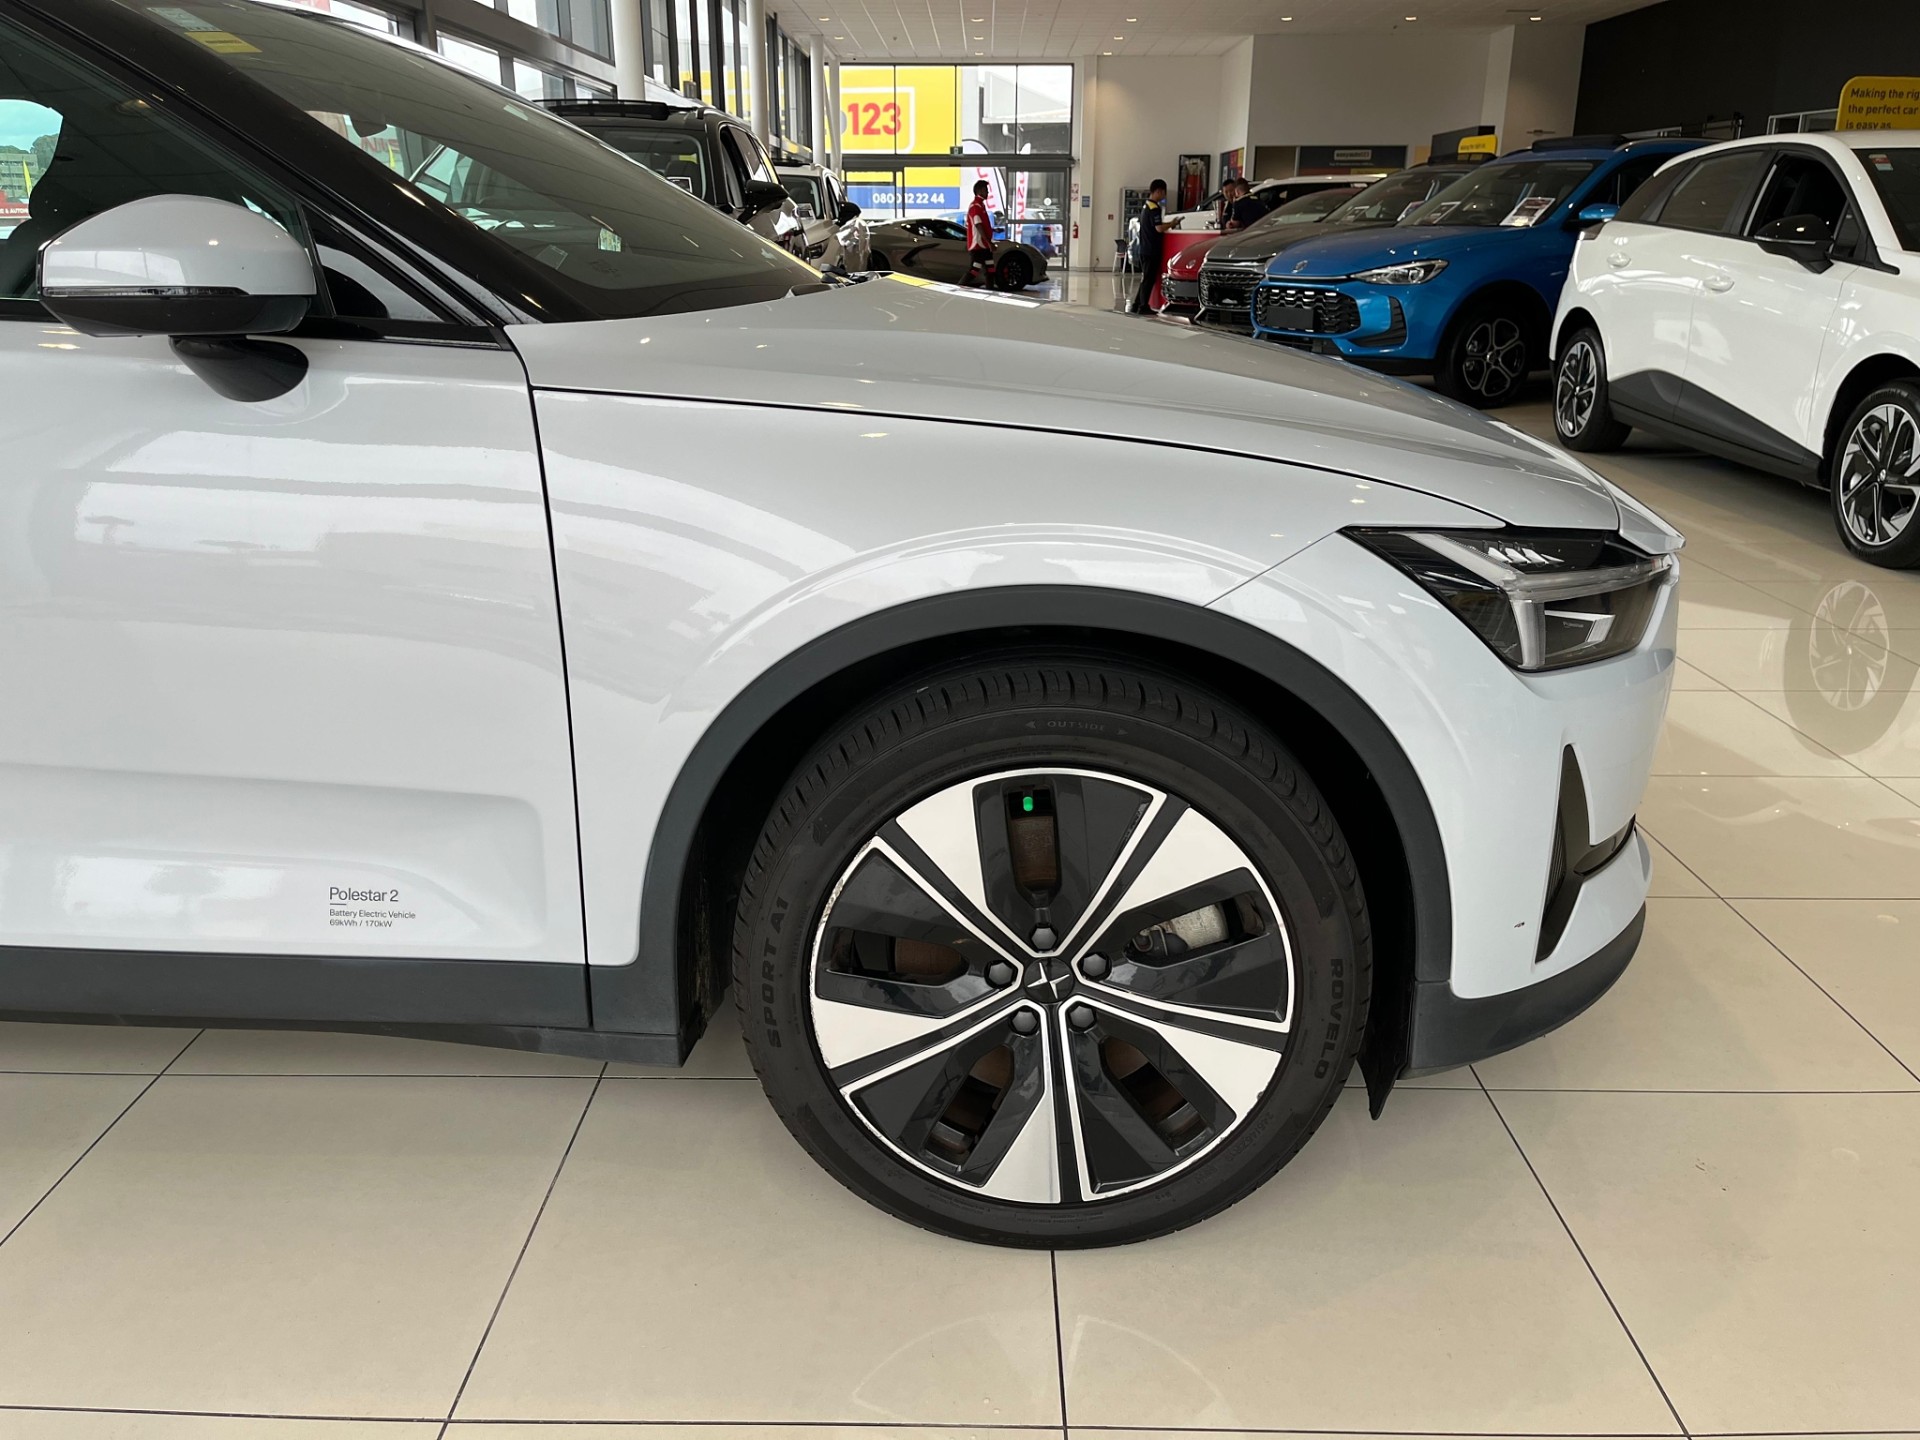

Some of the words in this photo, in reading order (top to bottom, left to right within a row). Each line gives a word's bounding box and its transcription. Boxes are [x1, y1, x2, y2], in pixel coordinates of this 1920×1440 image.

[1851, 88, 1886, 100] Making
[1888, 89, 1904, 99] the
[1848, 104, 1864, 114] the
[1866, 105, 1900, 116] perfect
[1903, 107, 1918, 115] car
[1846, 119, 1854, 129] is
[1856, 121, 1879, 129] easy
[1880, 121, 1892, 129] as
[873, 193, 902, 204] 0800
[916, 193, 929, 204] 22
[930, 193, 945, 204] 44
[1047, 720, 1105, 731] OUTSIDE
[329, 887, 387, 901] Polestar
[390, 889, 398, 902] 2
[329, 908, 358, 918] Battery
[359, 910, 387, 918] Electric
[388, 911, 416, 919] Vehicle
[770, 896, 790, 934] A1
[329, 919, 358, 927] 69kWh
[761, 937, 783, 1049] SPORT
[1314, 958, 1345, 1080] ROVELO
